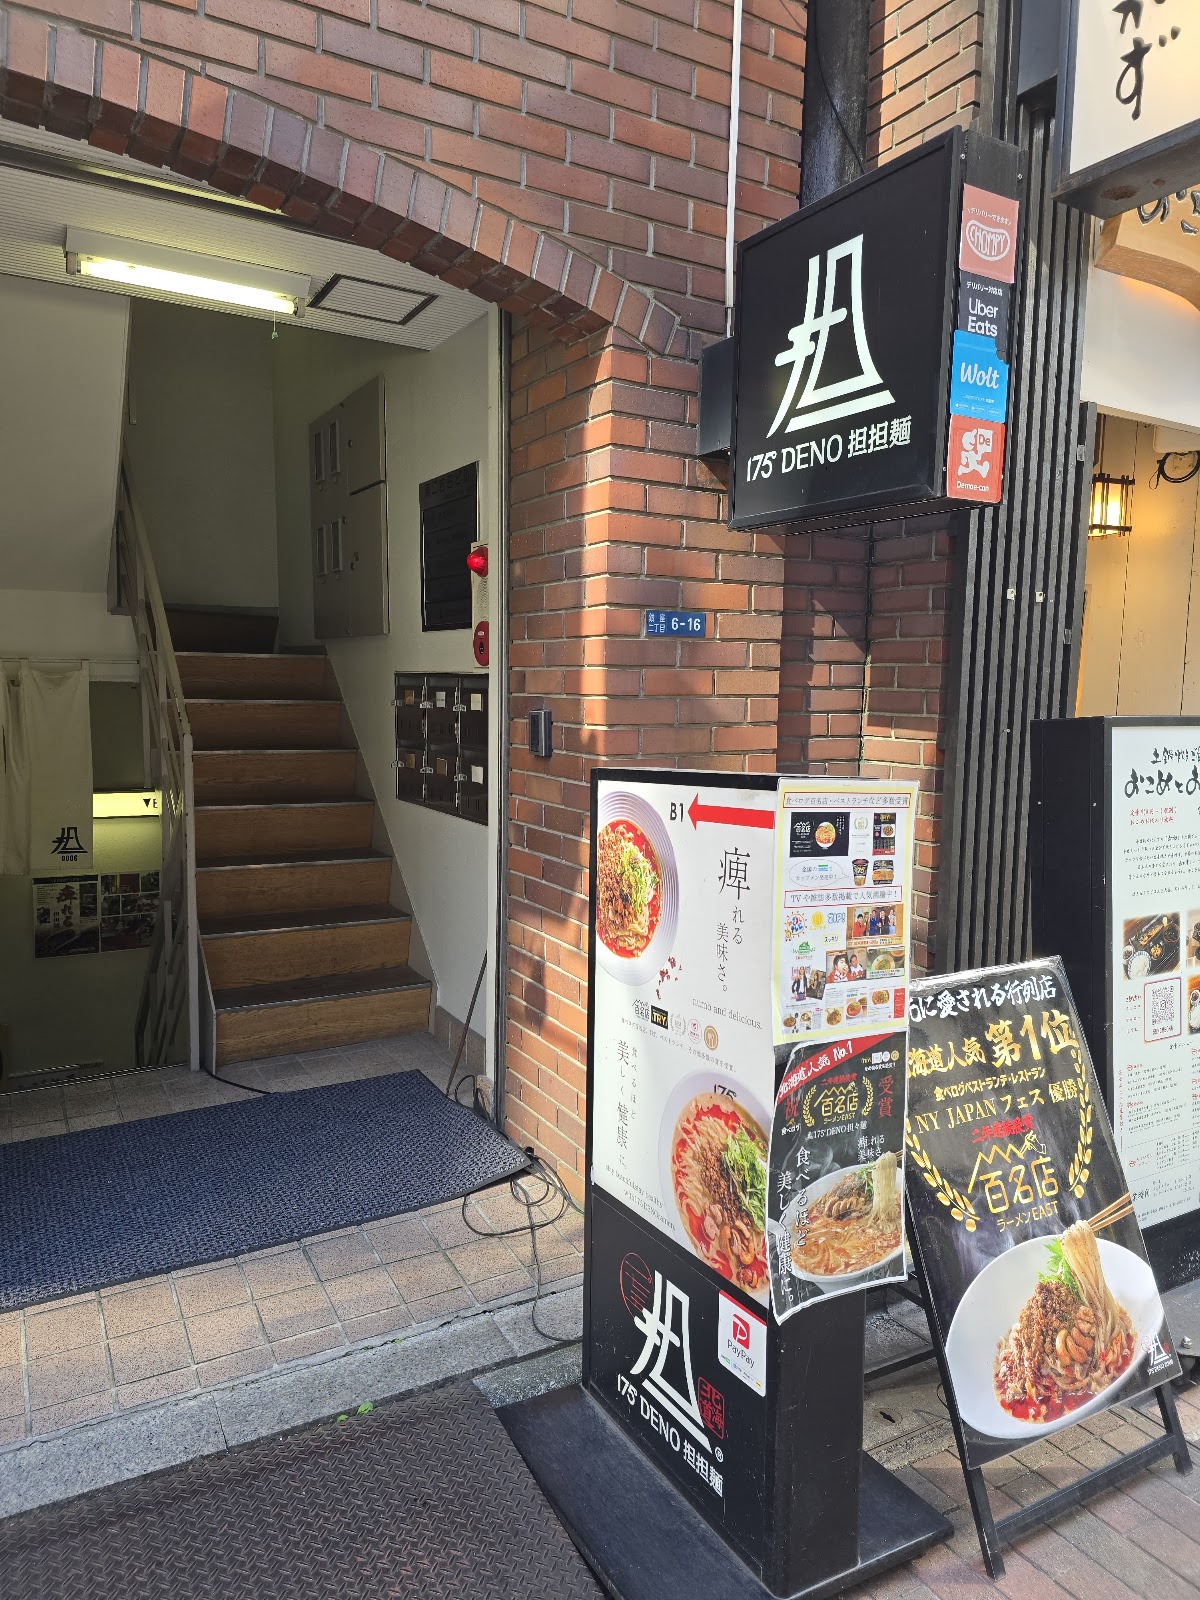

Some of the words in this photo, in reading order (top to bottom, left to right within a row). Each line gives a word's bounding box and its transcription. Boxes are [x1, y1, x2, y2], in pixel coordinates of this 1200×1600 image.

[970, 226, 1005, 255] CHOMPY
[968, 298, 998, 318] Uber
[967, 315, 998, 337] Eats
[960, 362, 1000, 390] Wolt
[747, 450, 777, 482] 175°
[782, 434, 842, 474] DENO
[847, 415, 912, 458] 担担麺
[648, 623, 666, 633] 二丁目
[671, 617, 701, 631] 6-16
[670, 802, 684, 822] B1
[652, 1012, 667, 1026] TRY
[692, 998, 712, 1012] numb
[713, 1005, 727, 1018] and
[728, 1009, 763, 1031] delicious.
[985, 1009, 1080, 1068] 第1位
[784, 1096, 799, 1120] 祝
[821, 1093, 859, 1117] 百名店
[878, 1075, 894, 1118] 受賞
[915, 1111, 940, 1135] NY
[947, 1099, 998, 1129] JAPAN
[999, 1088, 1045, 1114] フェス
[1048, 1078, 1078, 1104] 優勝
[781, 1123, 801, 1136] 食べログ
[795, 1145, 811, 1247] 食べるほど
[979, 1155, 1059, 1214] 百名店
[996, 1200, 1059, 1233] ラーメンEAST
[776, 1170, 794, 1302] 美しく健康に。
[727, 1339, 755, 1369] PayPay
[617, 1373, 638, 1406] 175°
[640, 1394, 681, 1452] DENO
[683, 1438, 723, 1498] 担担麺
